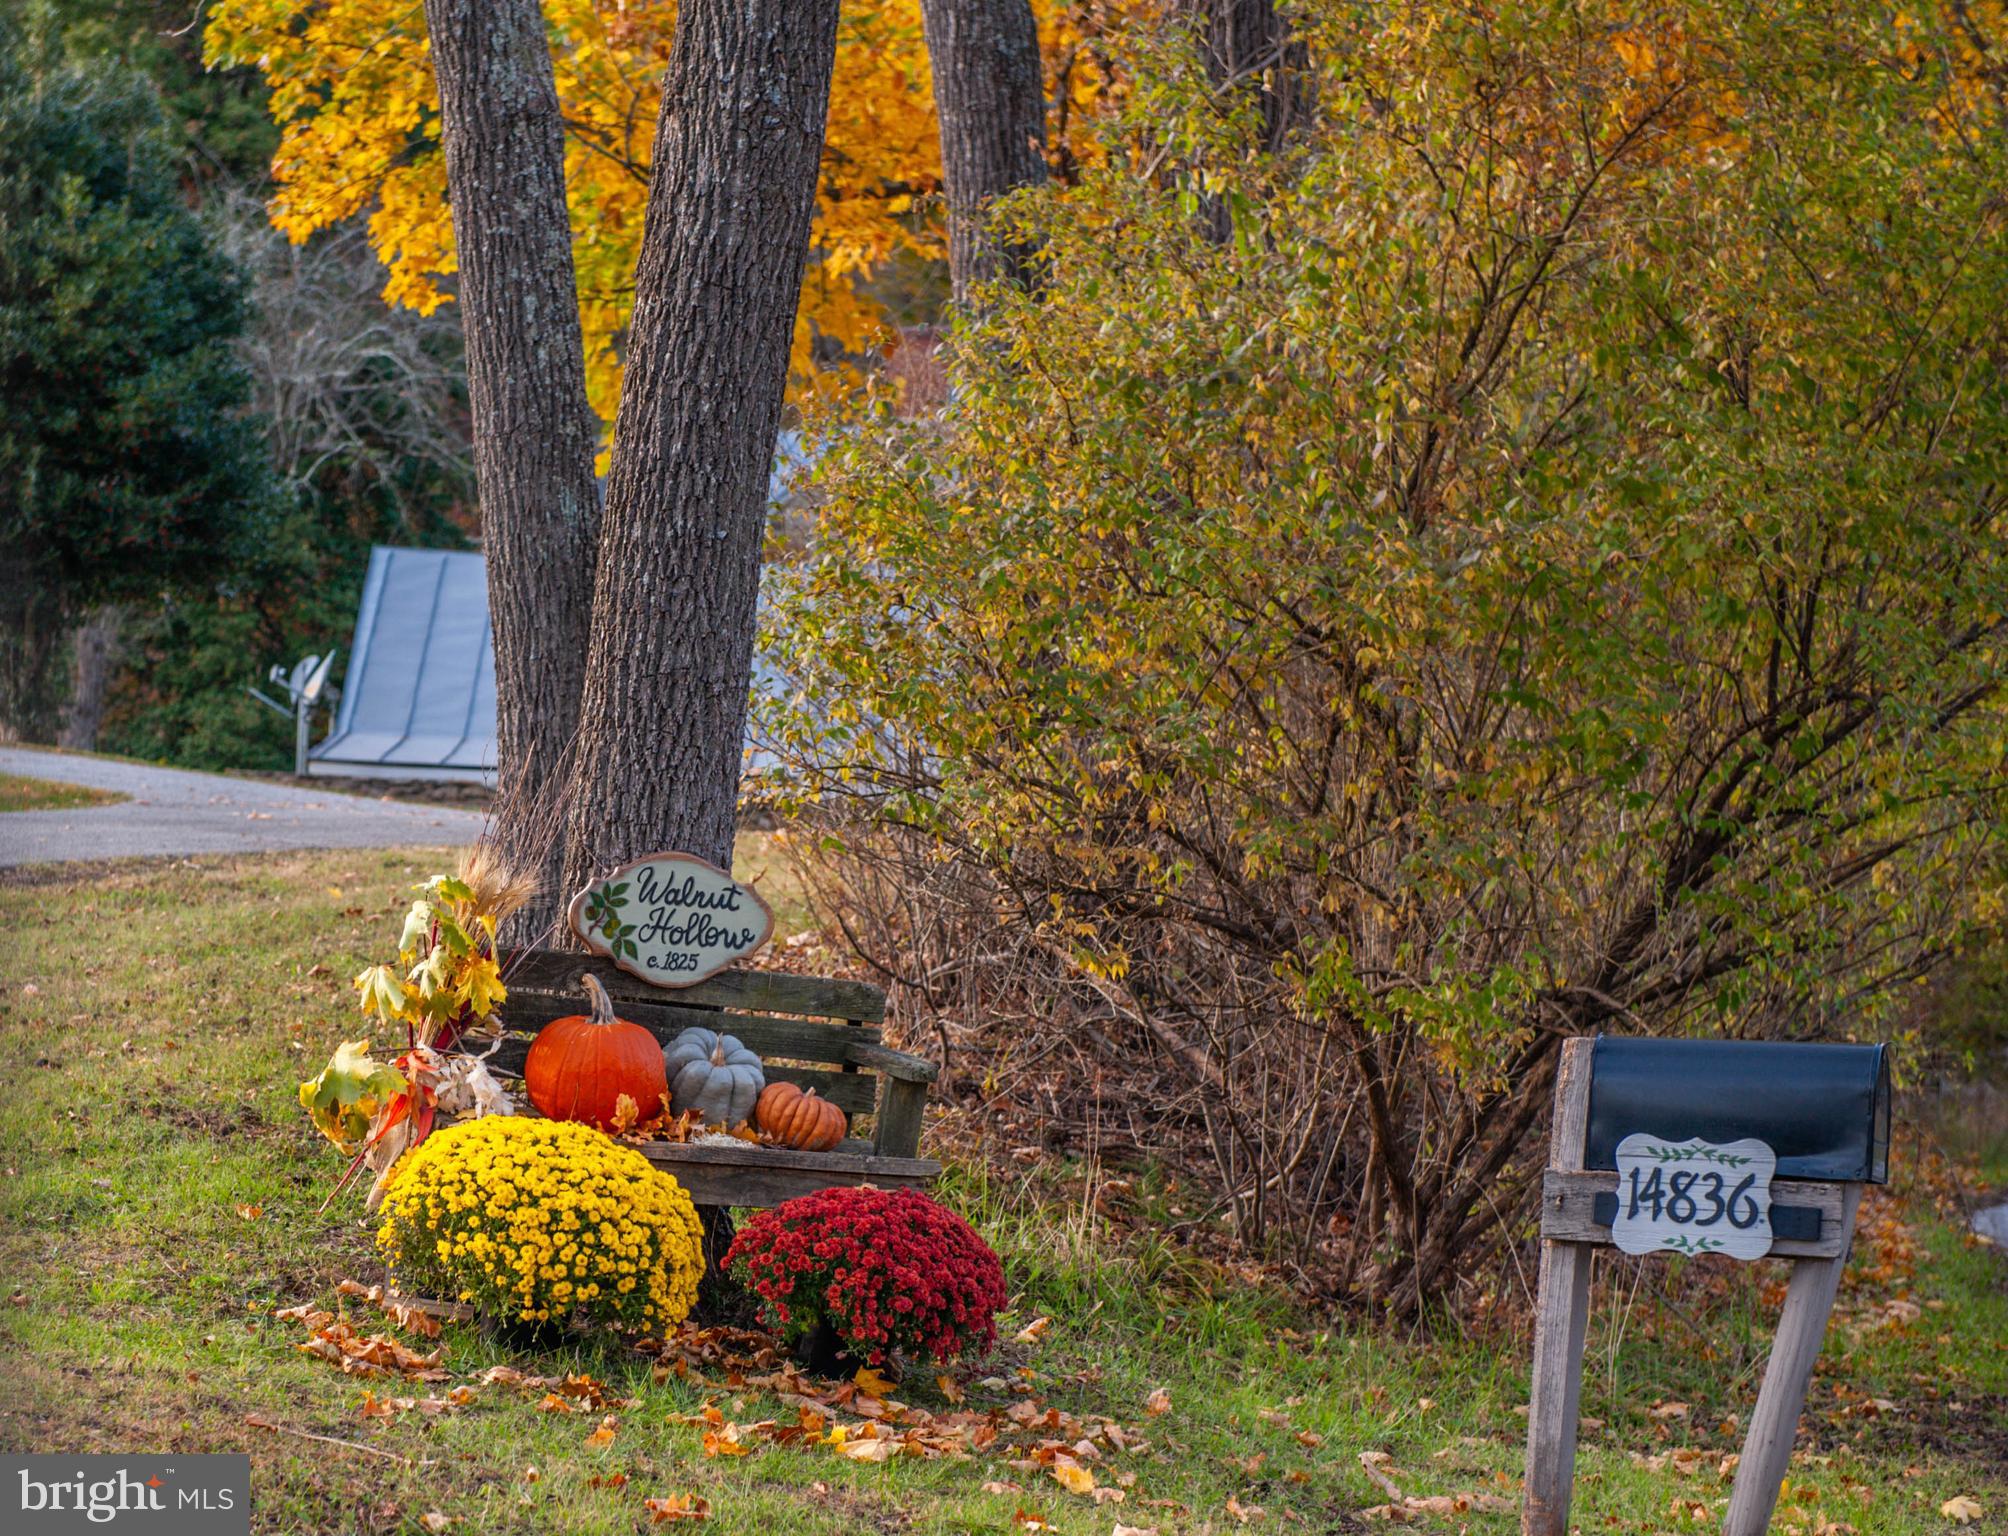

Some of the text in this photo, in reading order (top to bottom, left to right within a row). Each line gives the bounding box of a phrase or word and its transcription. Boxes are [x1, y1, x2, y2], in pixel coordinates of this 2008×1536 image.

[637, 866, 743, 911] Walnut
[638, 906, 755, 950] Hollow
[1627, 1166, 1759, 1229] 14836
